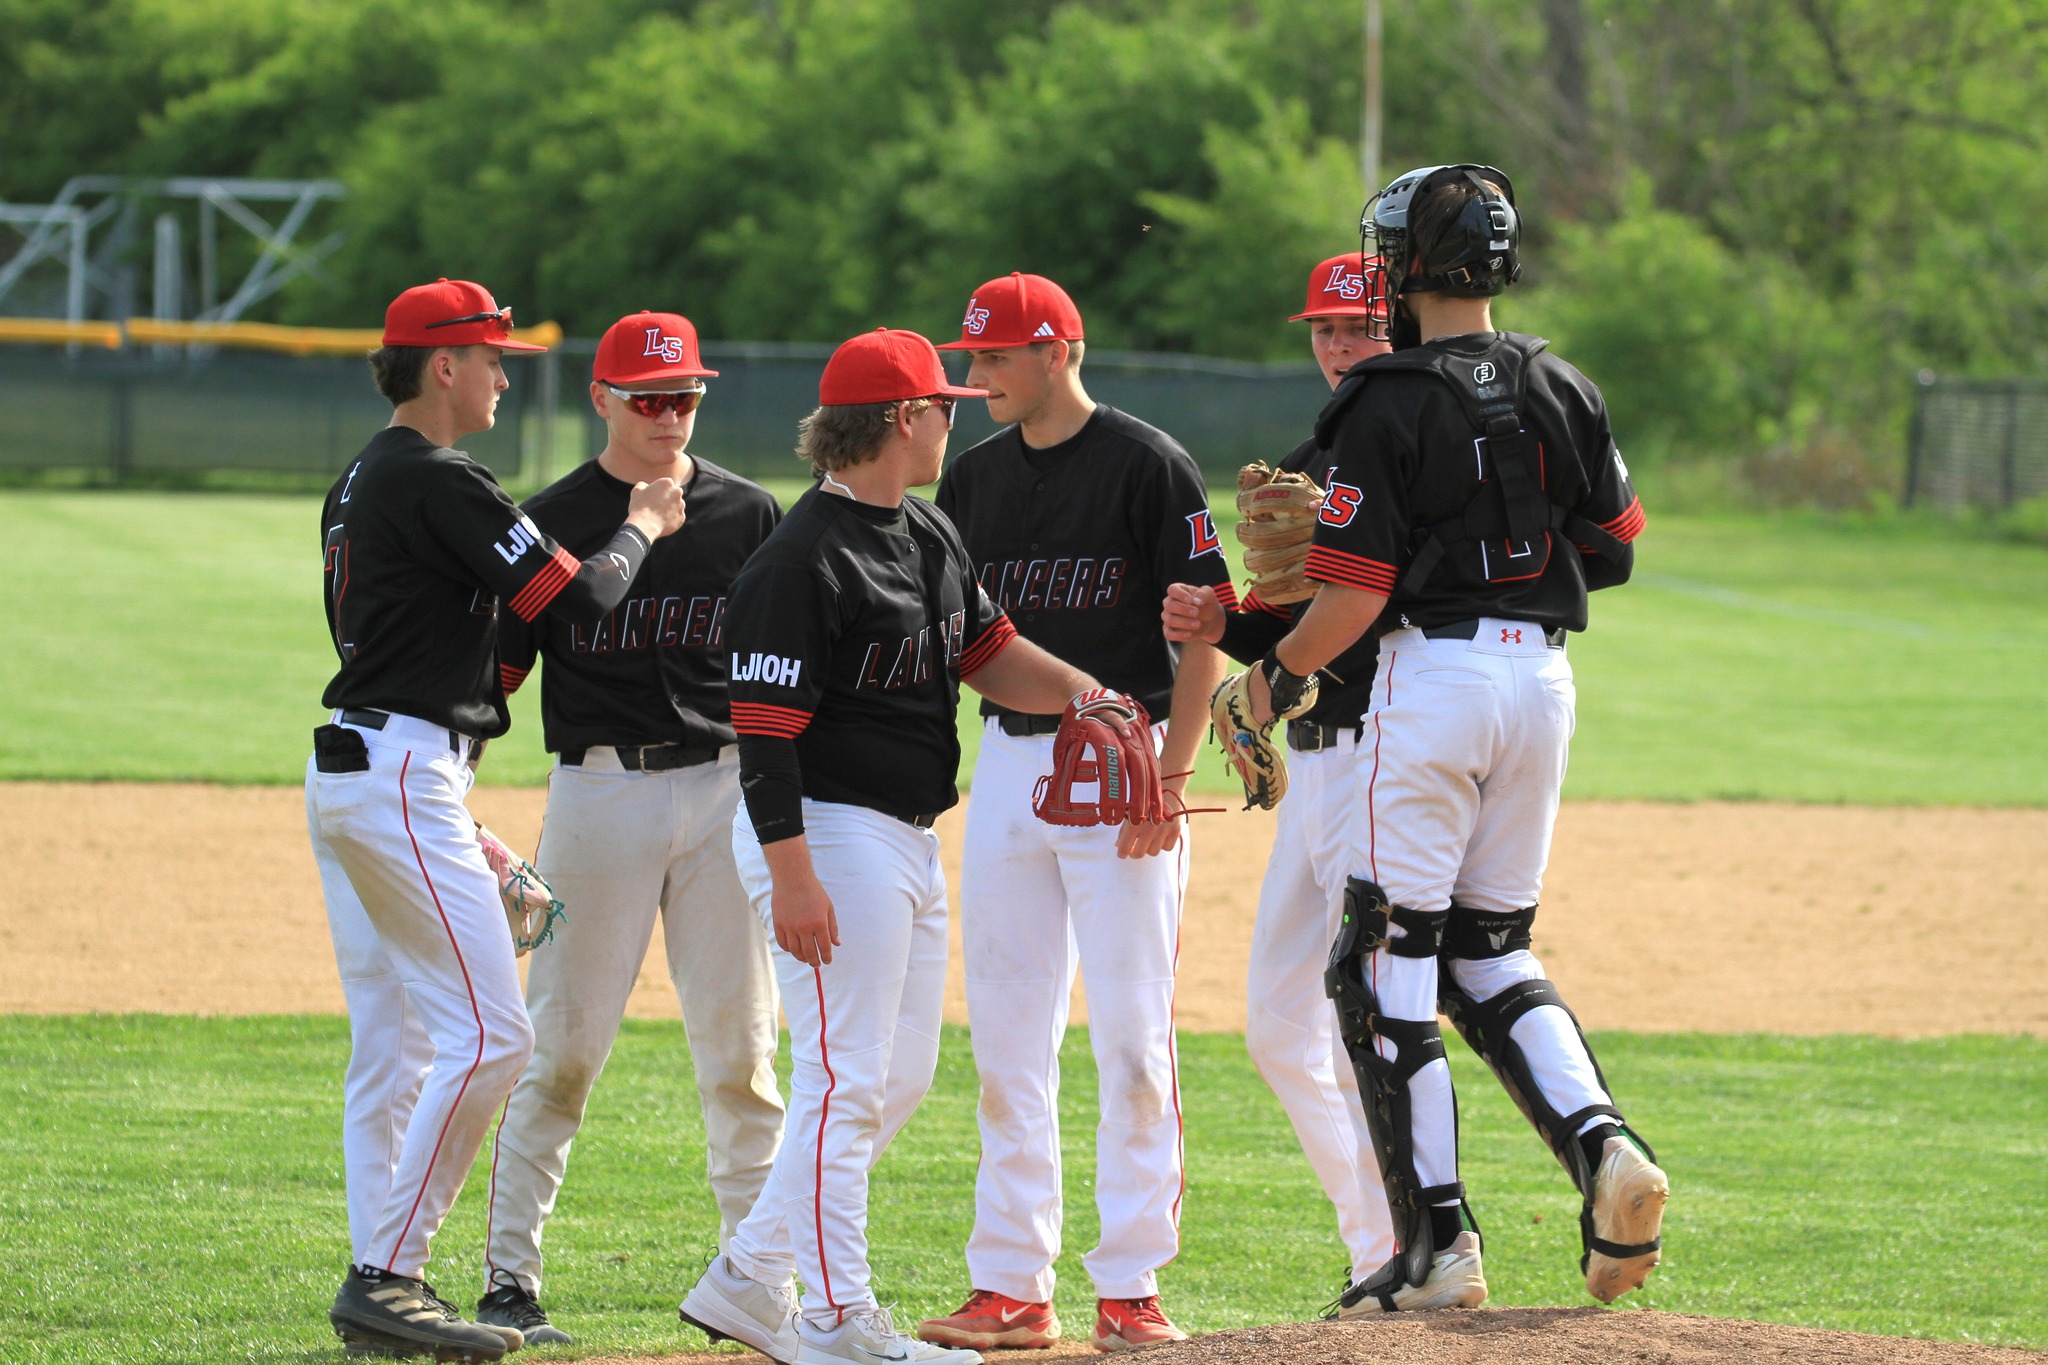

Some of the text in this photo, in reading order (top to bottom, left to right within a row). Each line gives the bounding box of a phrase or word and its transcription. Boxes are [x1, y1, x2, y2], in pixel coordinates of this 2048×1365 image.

[1323, 264, 1364, 300] LS
[962, 297, 990, 335] LS
[642, 327, 683, 363] LS
[493, 514, 542, 566] LJIO
[1184, 508, 1227, 561] L
[976, 557, 1127, 611] ANCERS
[571, 597, 726, 653] LANCER
[731, 652, 802, 688] LJIOH
[1102, 744, 1119, 799] marucci
